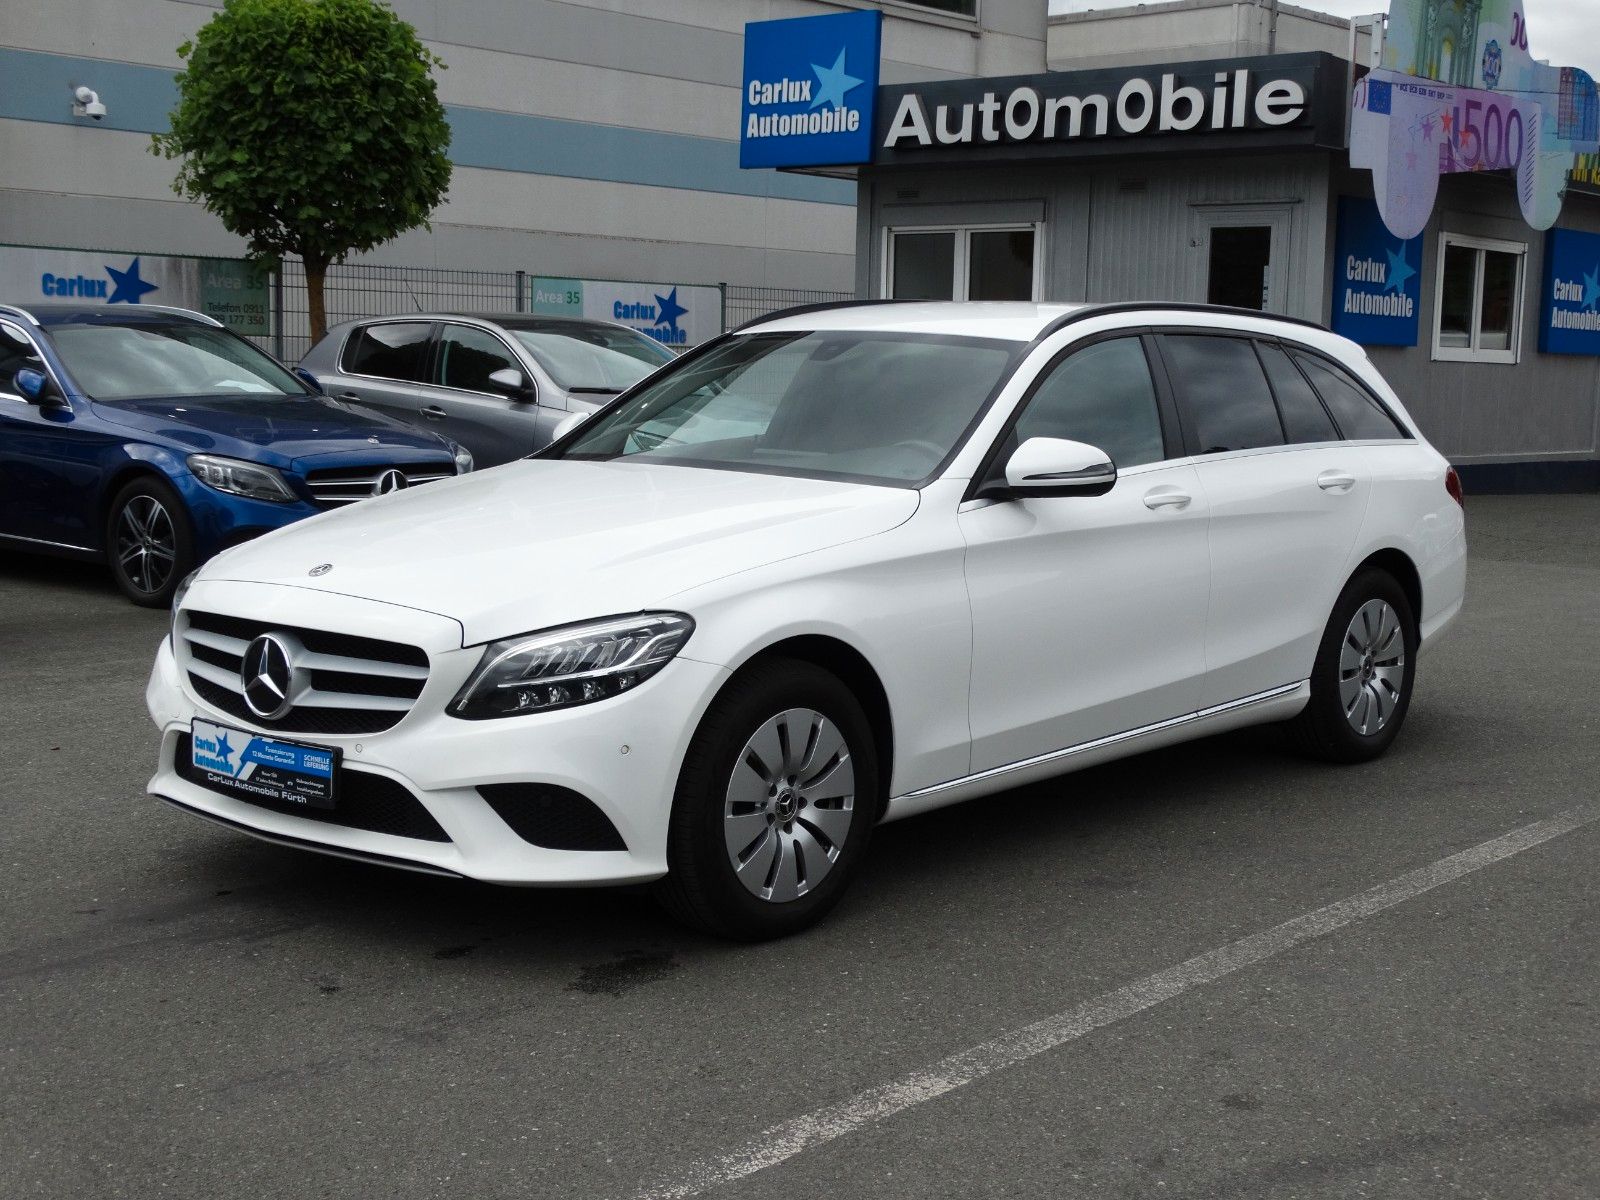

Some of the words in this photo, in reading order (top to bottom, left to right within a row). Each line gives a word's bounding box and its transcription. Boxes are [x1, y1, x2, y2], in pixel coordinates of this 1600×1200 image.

[748, 78, 812, 105] Carlux
[746, 107, 860, 139] Automobile
[1463, 99, 1524, 169] 500
[207, 272, 242, 290] Area
[246, 274, 264, 290] 35
[1346, 255, 1386, 284] Carlux
[42, 272, 108, 299] Carlux
[535, 290, 563, 304] Area
[566, 291, 581, 305] 35
[1553, 278, 1584, 302] Carlux
[207, 302, 241, 314] Telefon
[243, 304, 265, 315] 0911
[613, 300, 656, 321] Carlux
[1344, 288, 1413, 318] Automobile
[229, 315, 245, 325] 177
[247, 315, 265, 325] 350
[304, 754, 330, 765] SCHNELLE
[207, 772, 234, 787] CarLux
[234, 780, 279, 798] Automobile
[281, 791, 307, 804] Fürth
